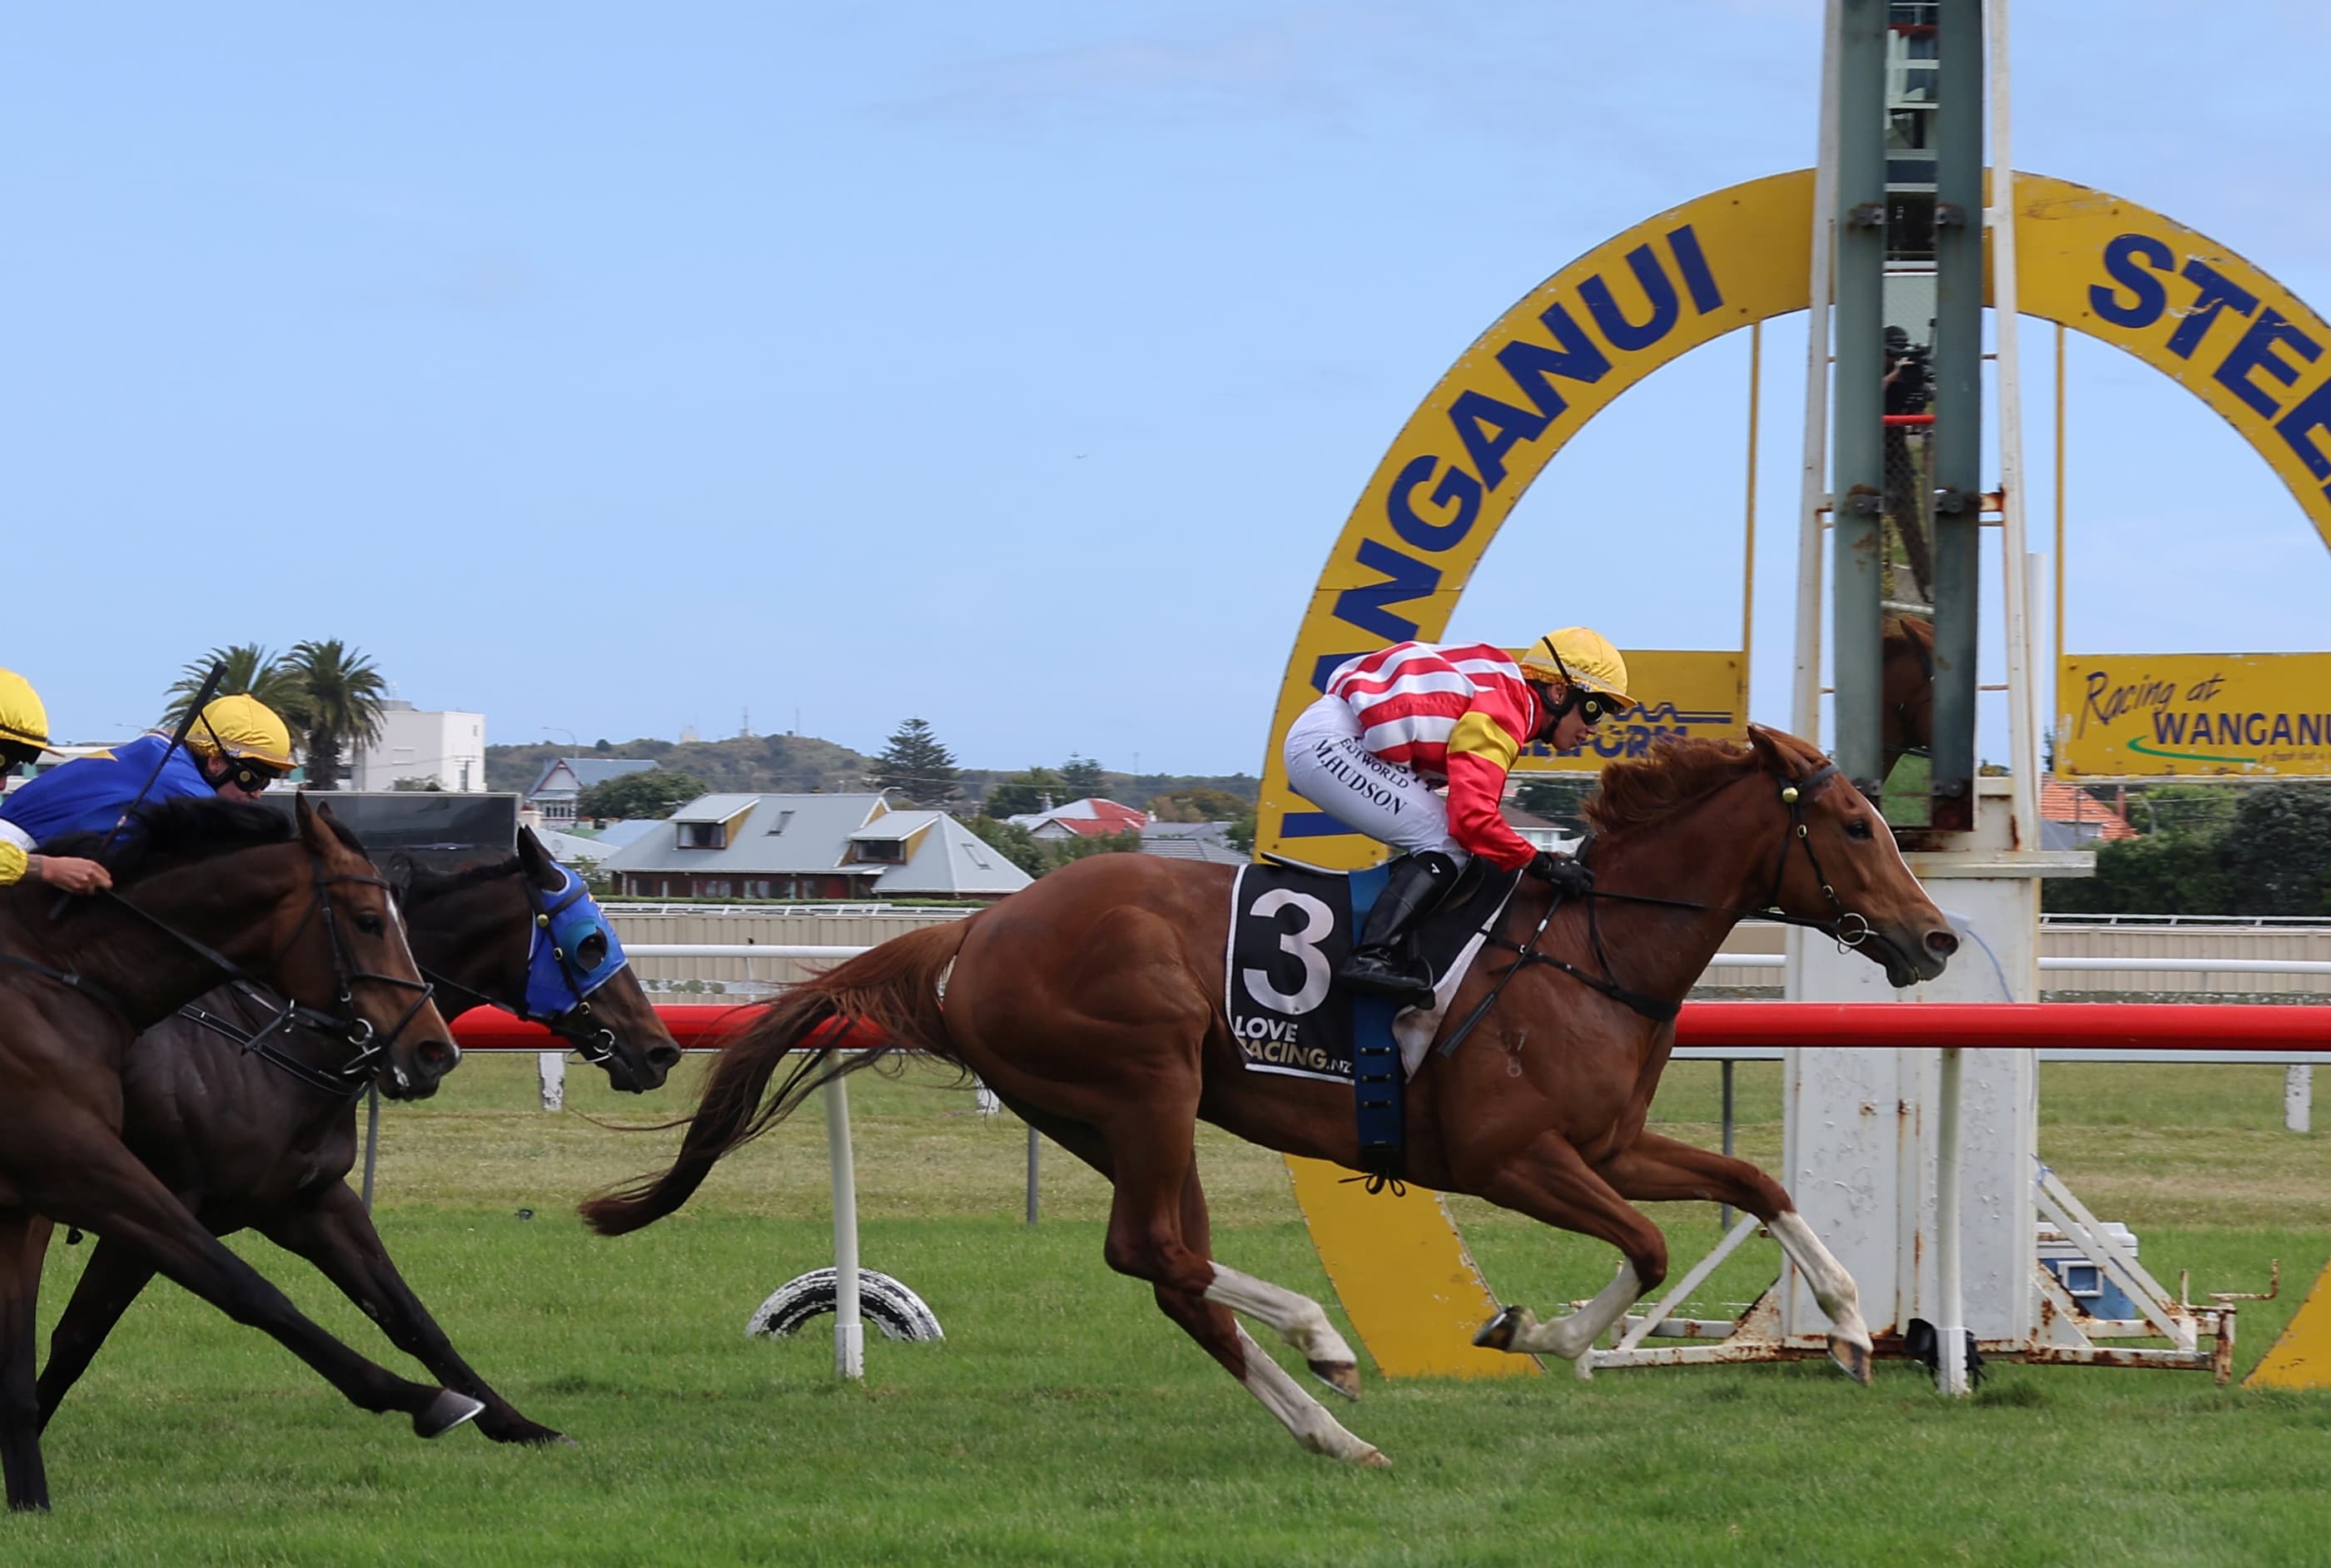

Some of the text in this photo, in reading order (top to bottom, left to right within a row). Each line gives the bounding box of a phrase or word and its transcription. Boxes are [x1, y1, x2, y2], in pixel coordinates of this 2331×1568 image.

[1280, 224, 2331, 838] NGANUI STEE
[2077, 671, 2226, 740] Racing at
[1312, 739, 1409, 816] M.HUDSON
[1243, 888, 1334, 1015] 3
[1235, 1015, 1299, 1043] LOVE
